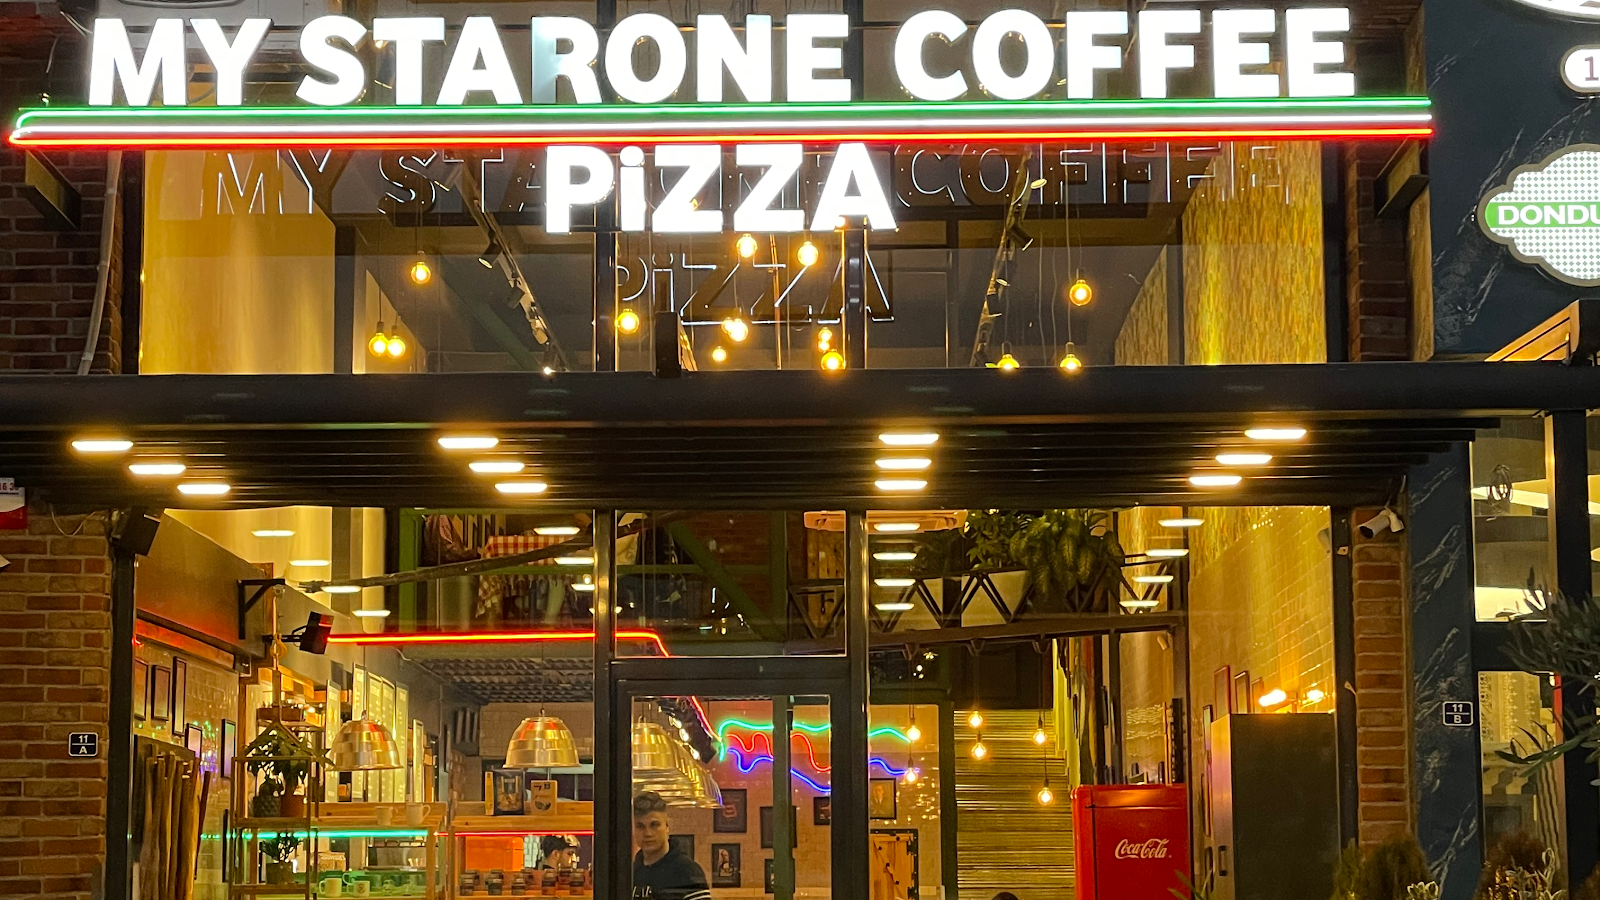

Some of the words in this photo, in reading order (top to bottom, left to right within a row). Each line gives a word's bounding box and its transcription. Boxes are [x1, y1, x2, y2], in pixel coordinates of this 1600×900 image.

[89, 18, 274, 106] MY
[296, 14, 852, 105] STARONE
[895, 8, 1356, 100] COFFEE
[546, 143, 898, 233] PiZZA
[1452, 703, 1463, 712] 11
[1453, 714, 1462, 723] B
[78, 735, 89, 743] 11
[79, 745, 88, 754] A
[1115, 838, 1170, 859] Coca-Cola
